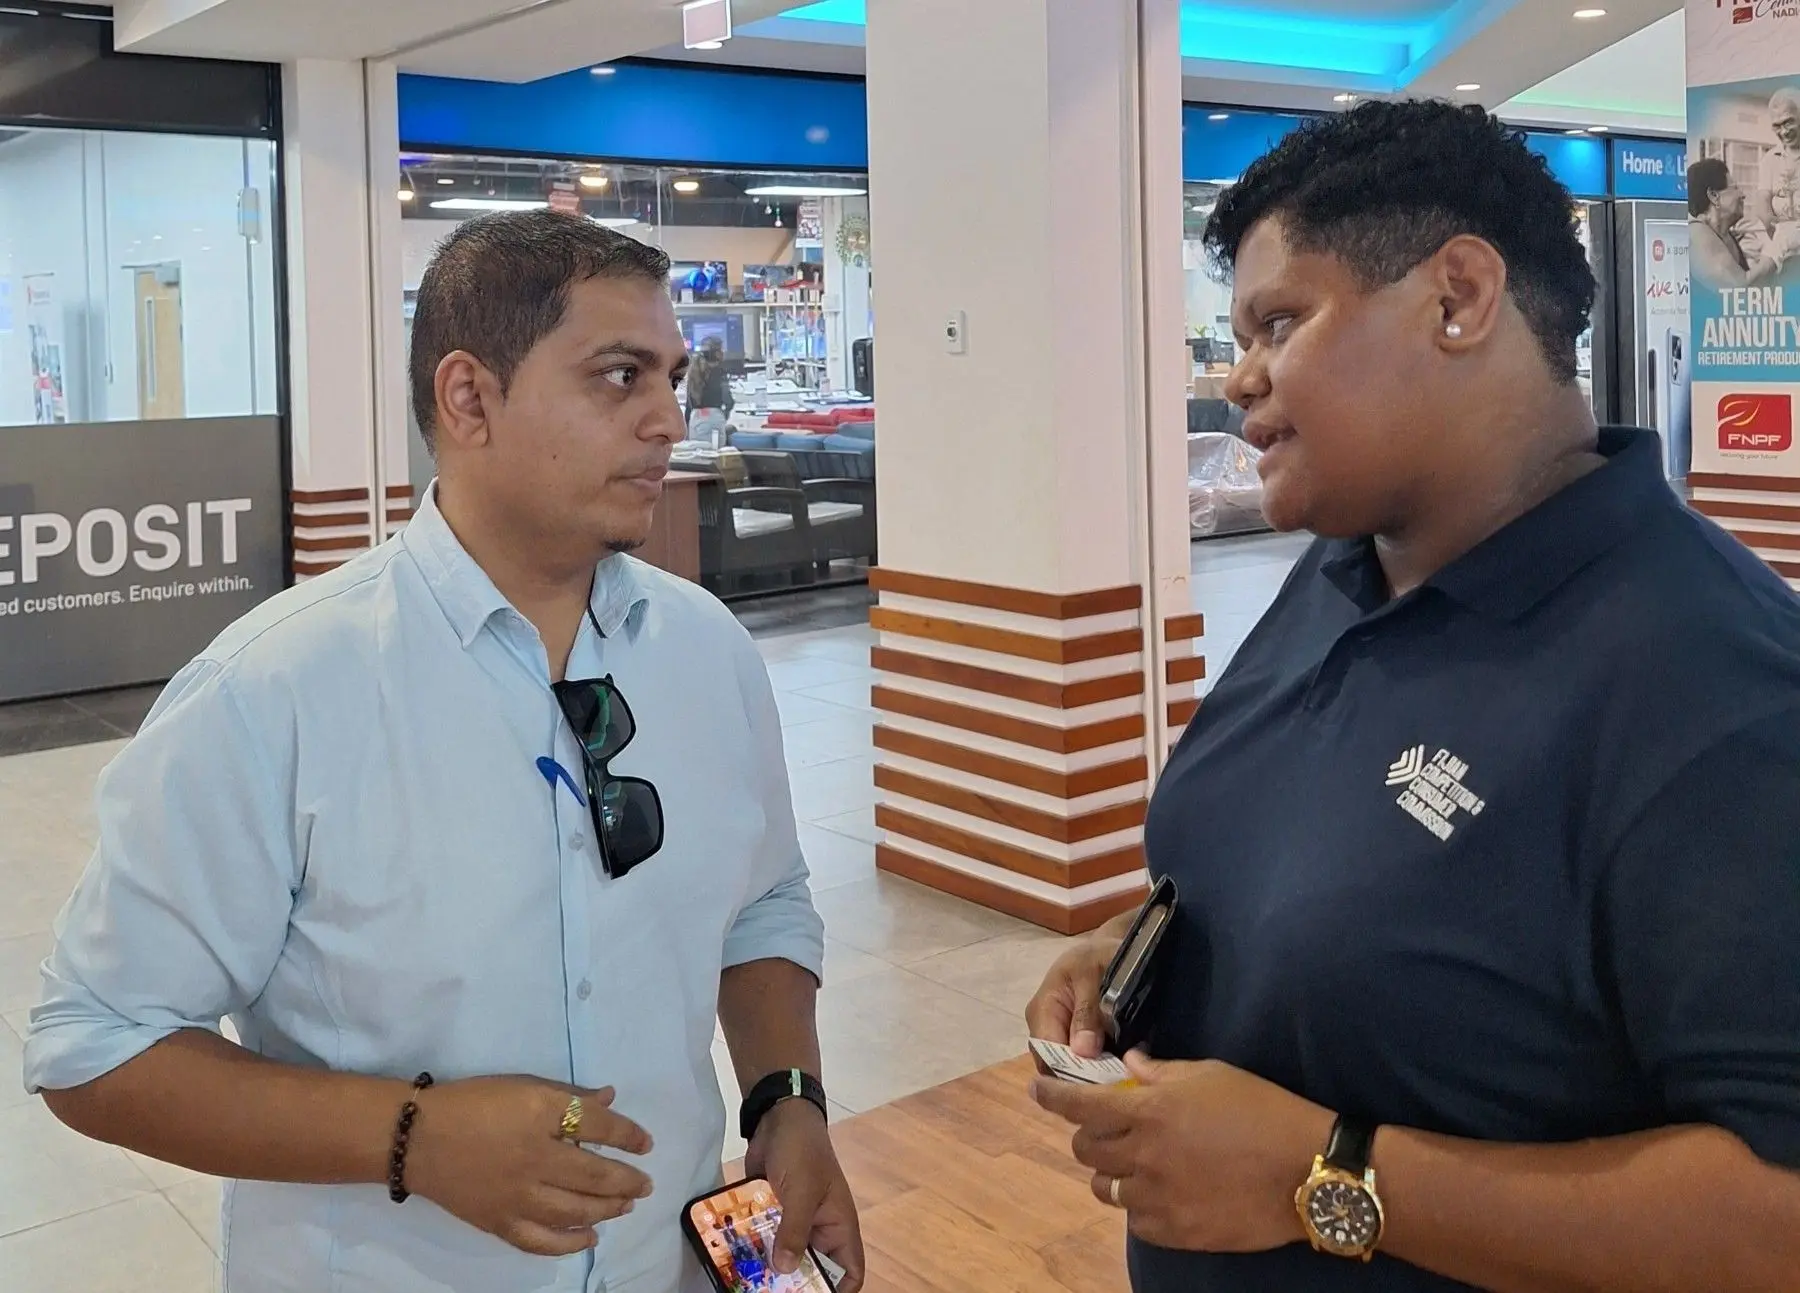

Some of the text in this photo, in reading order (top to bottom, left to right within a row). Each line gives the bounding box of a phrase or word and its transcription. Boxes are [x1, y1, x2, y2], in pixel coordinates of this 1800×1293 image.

[1622, 150, 1663, 176] Home
[1665, 154, 1676, 176] &
[1718, 286, 1784, 316] TERM
[1702, 316, 1800, 348] ANNUITY
[1697, 351, 1800, 366] RETIREMENT PRODU
[1727, 433, 1782, 446] FNPF
[24, 588, 125, 614] customers.
[129, 582, 195, 603] Enquire
[198, 575, 254, 595] within.
